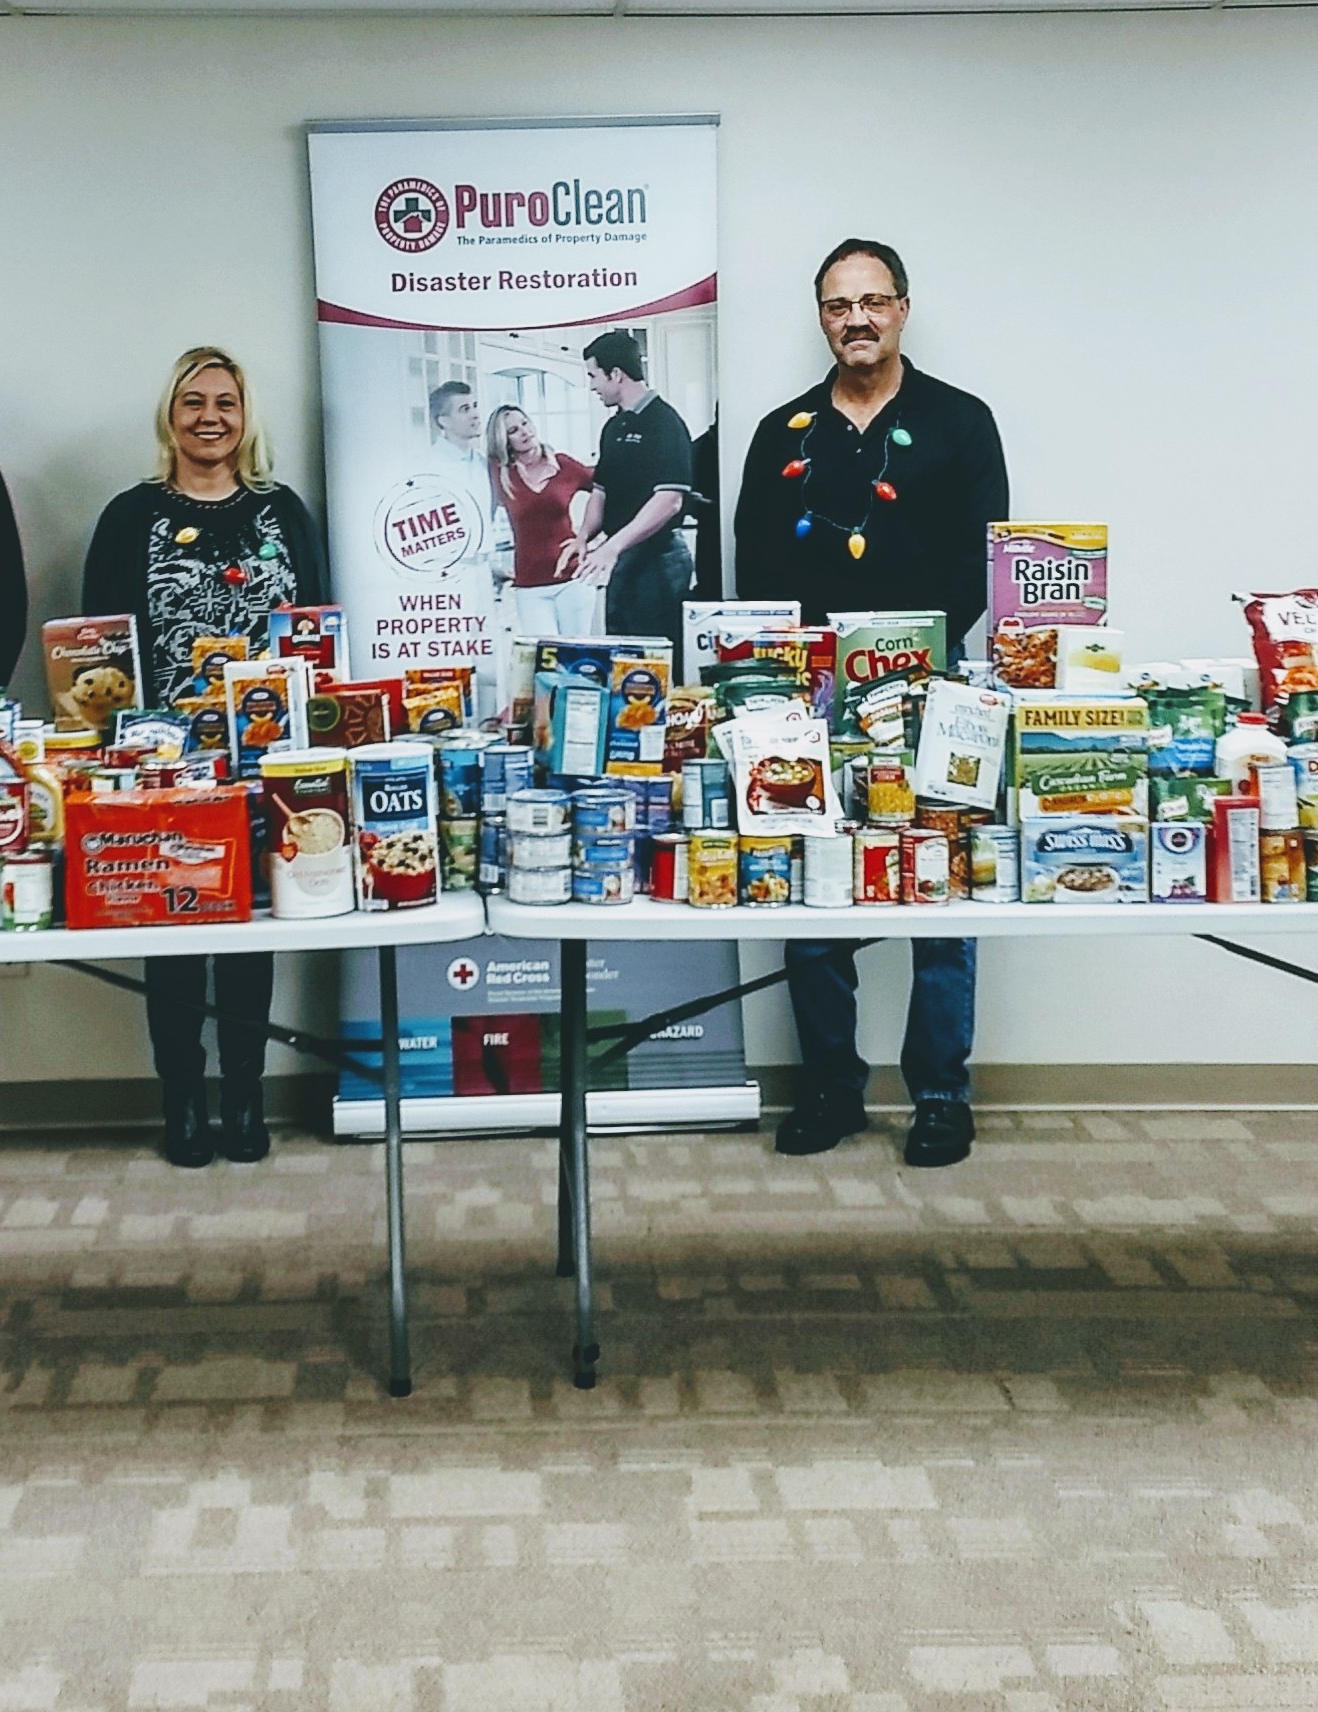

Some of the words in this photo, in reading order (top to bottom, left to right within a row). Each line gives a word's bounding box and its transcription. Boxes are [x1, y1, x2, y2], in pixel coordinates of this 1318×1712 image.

[454, 178, 647, 229] PuroClean
[456, 236, 476, 246] The
[479, 233, 539, 246] Paramedics
[541, 233, 553, 244] of
[556, 232, 601, 247] Property
[604, 231, 647, 244] Damage
[391, 272, 492, 293] Disaster
[498, 267, 638, 291] Restoration
[392, 502, 462, 543] TIME
[401, 527, 466, 559] MATTERS
[1014, 559, 1089, 581] Raisin
[398, 593, 462, 612] WHEN
[1023, 582, 1080, 604] Bran
[377, 615, 487, 636] PROPERTY
[372, 642, 390, 660] IS
[397, 641, 421, 658] AT
[427, 638, 494, 657] STAKE
[876, 636, 914, 653] Corn
[540, 646, 559, 669] 5
[844, 647, 933, 684] Chex
[1024, 710, 1081, 726] FAMILY
[370, 789, 423, 813] OATS
[101, 831, 183, 846] Maruchan
[86, 858, 170, 873] Ramen
[162, 886, 199, 913] 12
[486, 959, 550, 972] American
[486, 972, 512, 984] Red
[512, 971, 550, 984] Cross
[398, 1036, 437, 1050] WATER
[483, 1032, 510, 1046] FIRE
